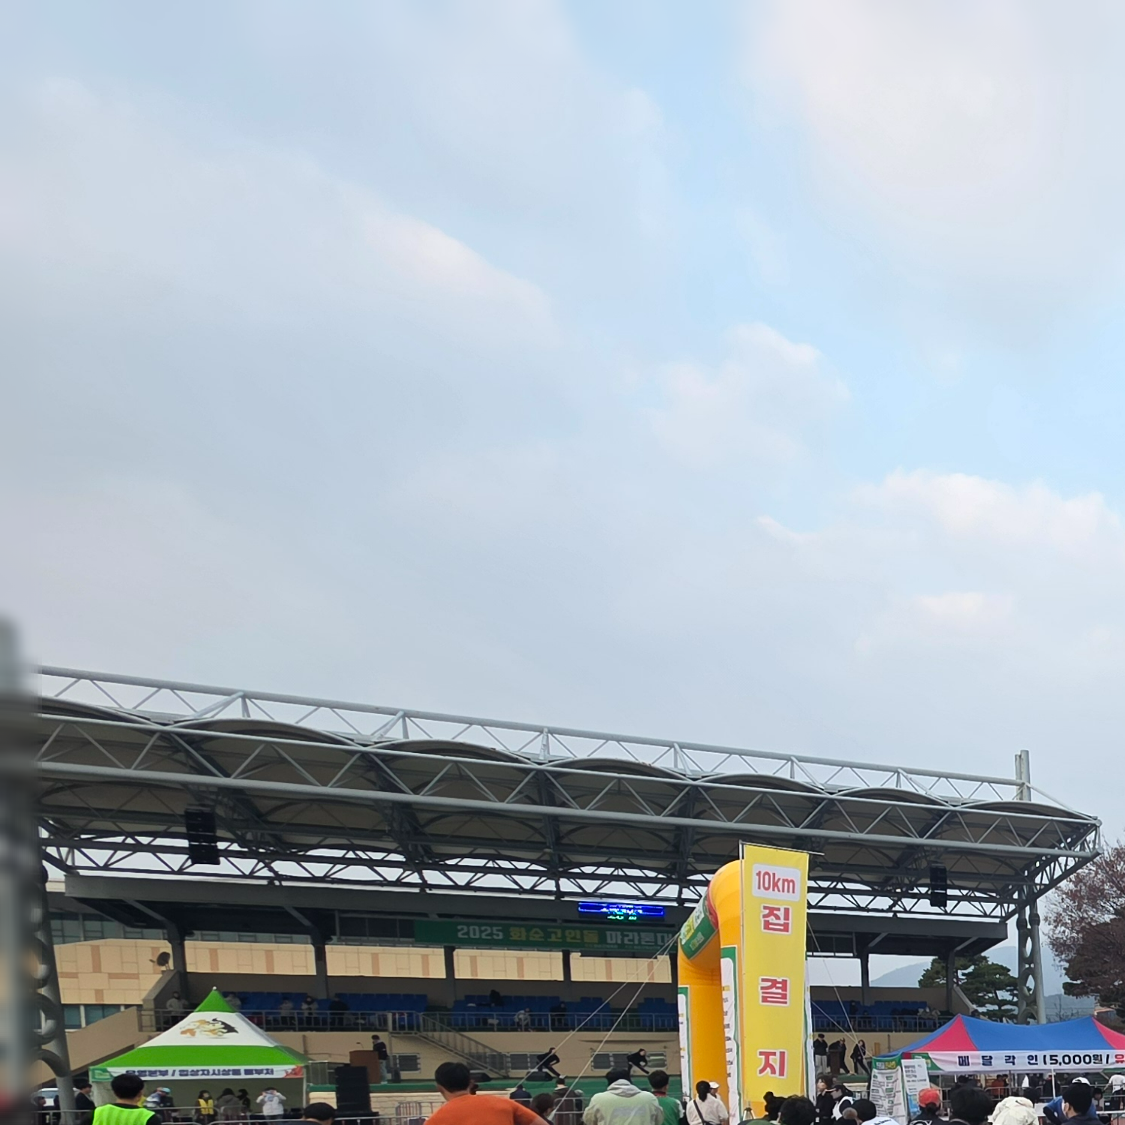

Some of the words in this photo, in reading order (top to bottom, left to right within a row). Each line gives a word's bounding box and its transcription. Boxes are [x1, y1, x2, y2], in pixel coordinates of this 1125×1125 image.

[755, 870, 796, 894] 10km
[457, 924, 504, 940] 2025
[509, 927, 599, 944] 화순고인돌
[605, 930, 677, 946] 마라톤대
